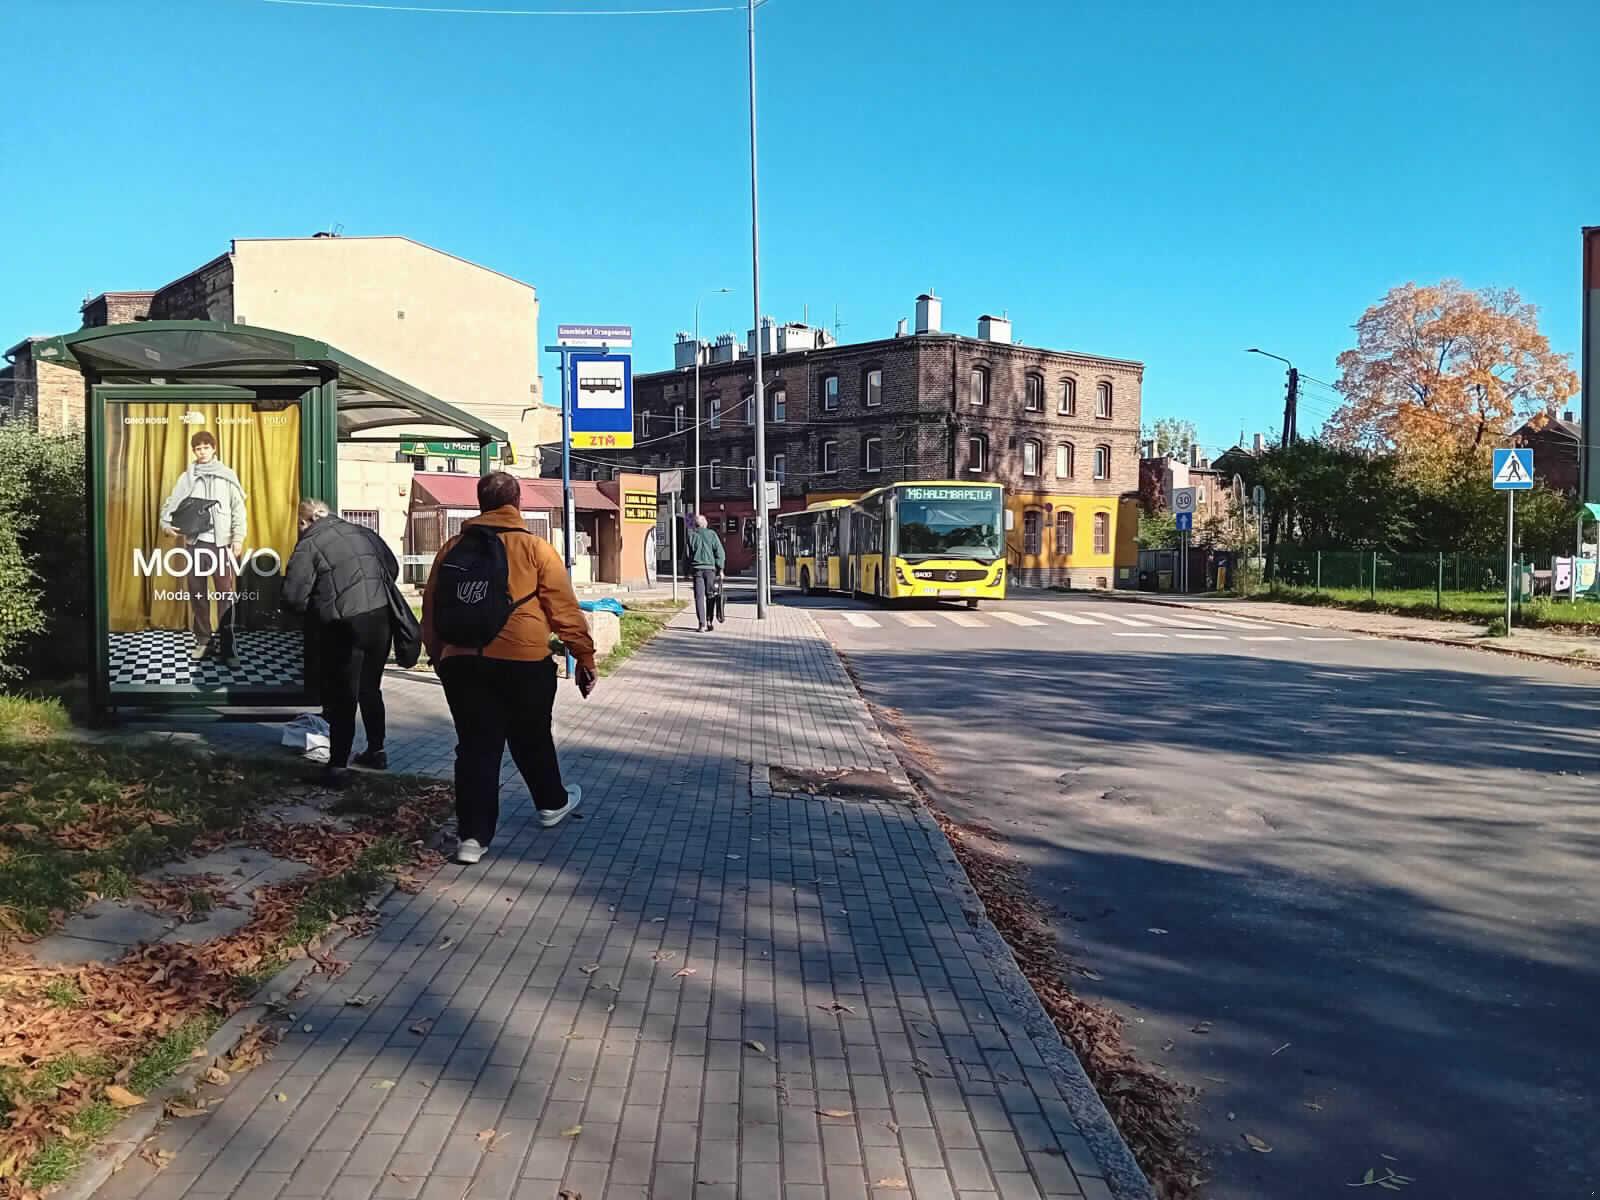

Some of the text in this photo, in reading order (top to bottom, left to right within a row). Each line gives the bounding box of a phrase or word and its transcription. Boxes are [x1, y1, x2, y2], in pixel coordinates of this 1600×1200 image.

[590, 434, 616, 447] ZTM
[1178, 496, 1190, 505] 30
[132, 547, 281, 577] MODIVO
[153, 589, 191, 601] Moda
[207, 588, 260, 602] korzyści
